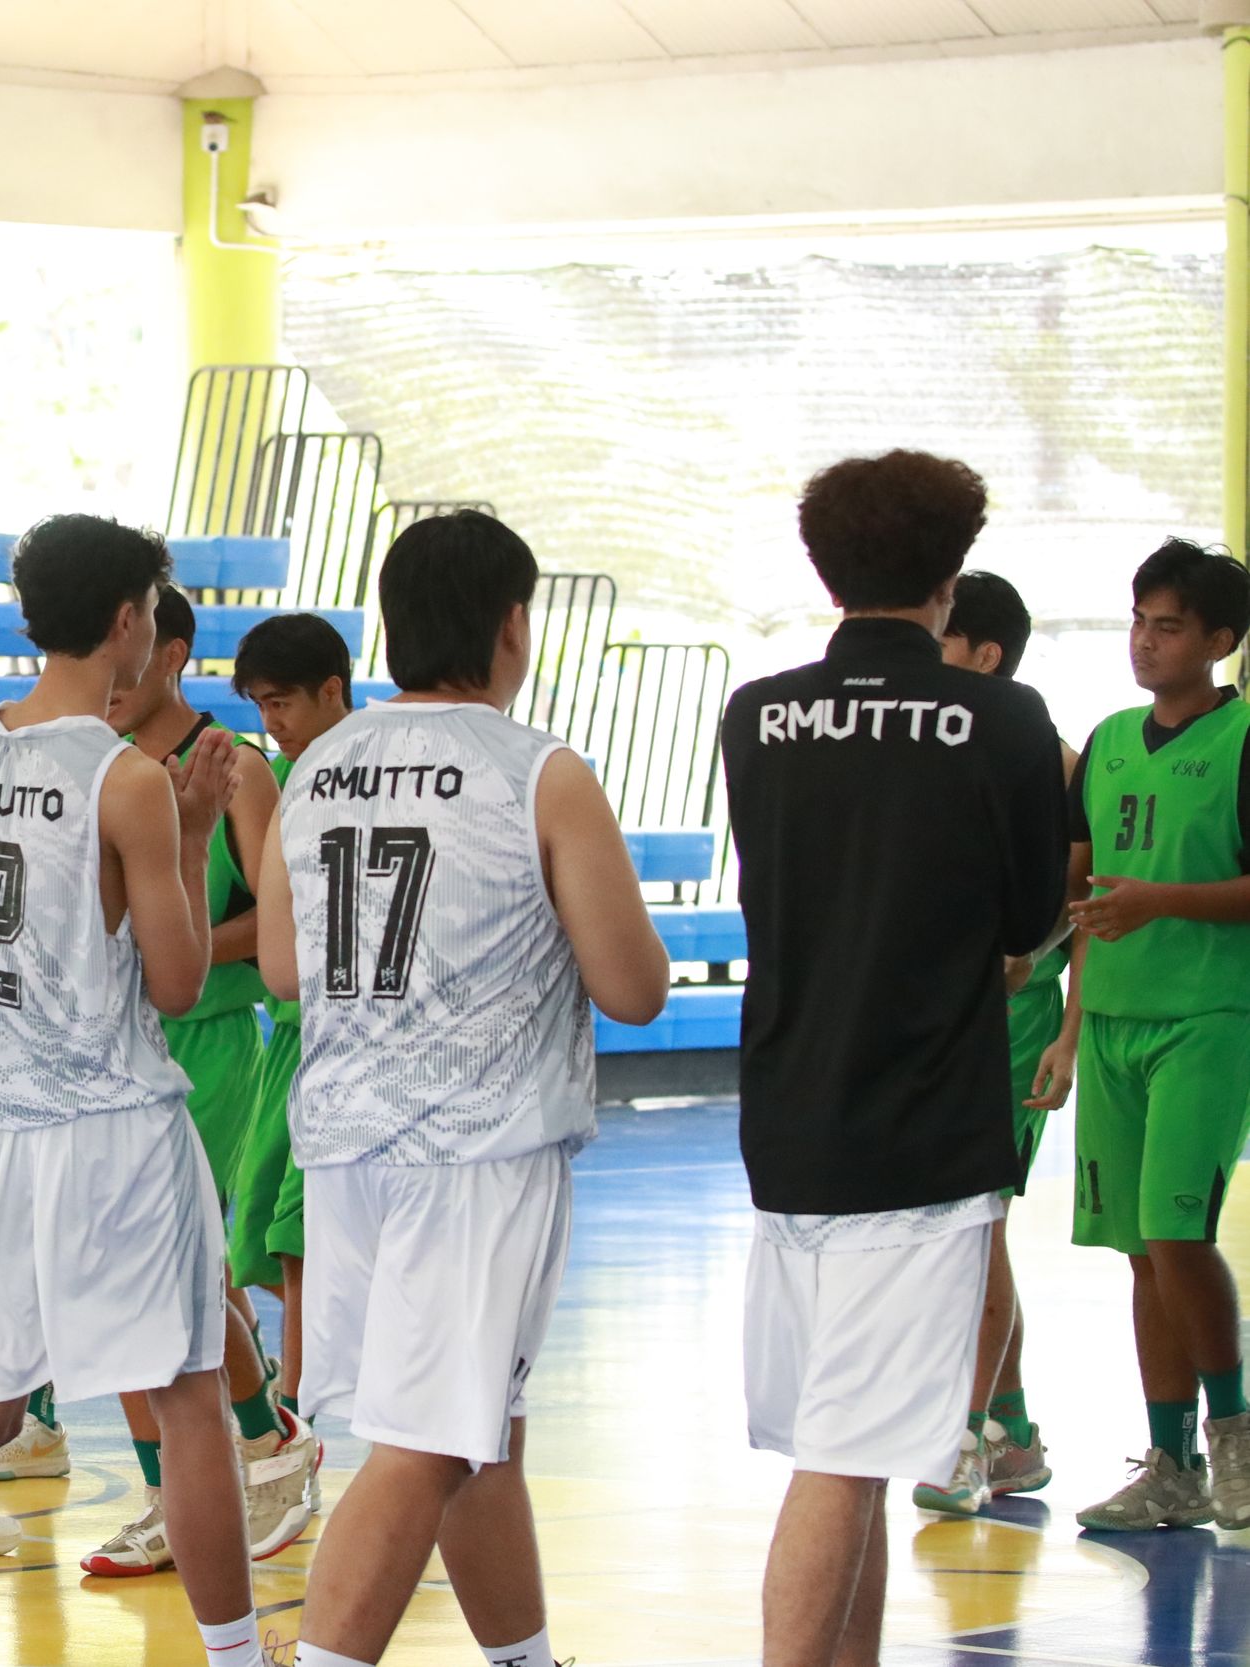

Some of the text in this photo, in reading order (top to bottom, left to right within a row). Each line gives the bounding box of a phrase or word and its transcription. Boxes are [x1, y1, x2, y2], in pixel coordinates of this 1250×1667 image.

[759, 699, 974, 746] RMUTTO
[310, 764, 464, 801] RMUTTO
[1115, 794, 1157, 851] 31
[320, 826, 437, 1000] 17
